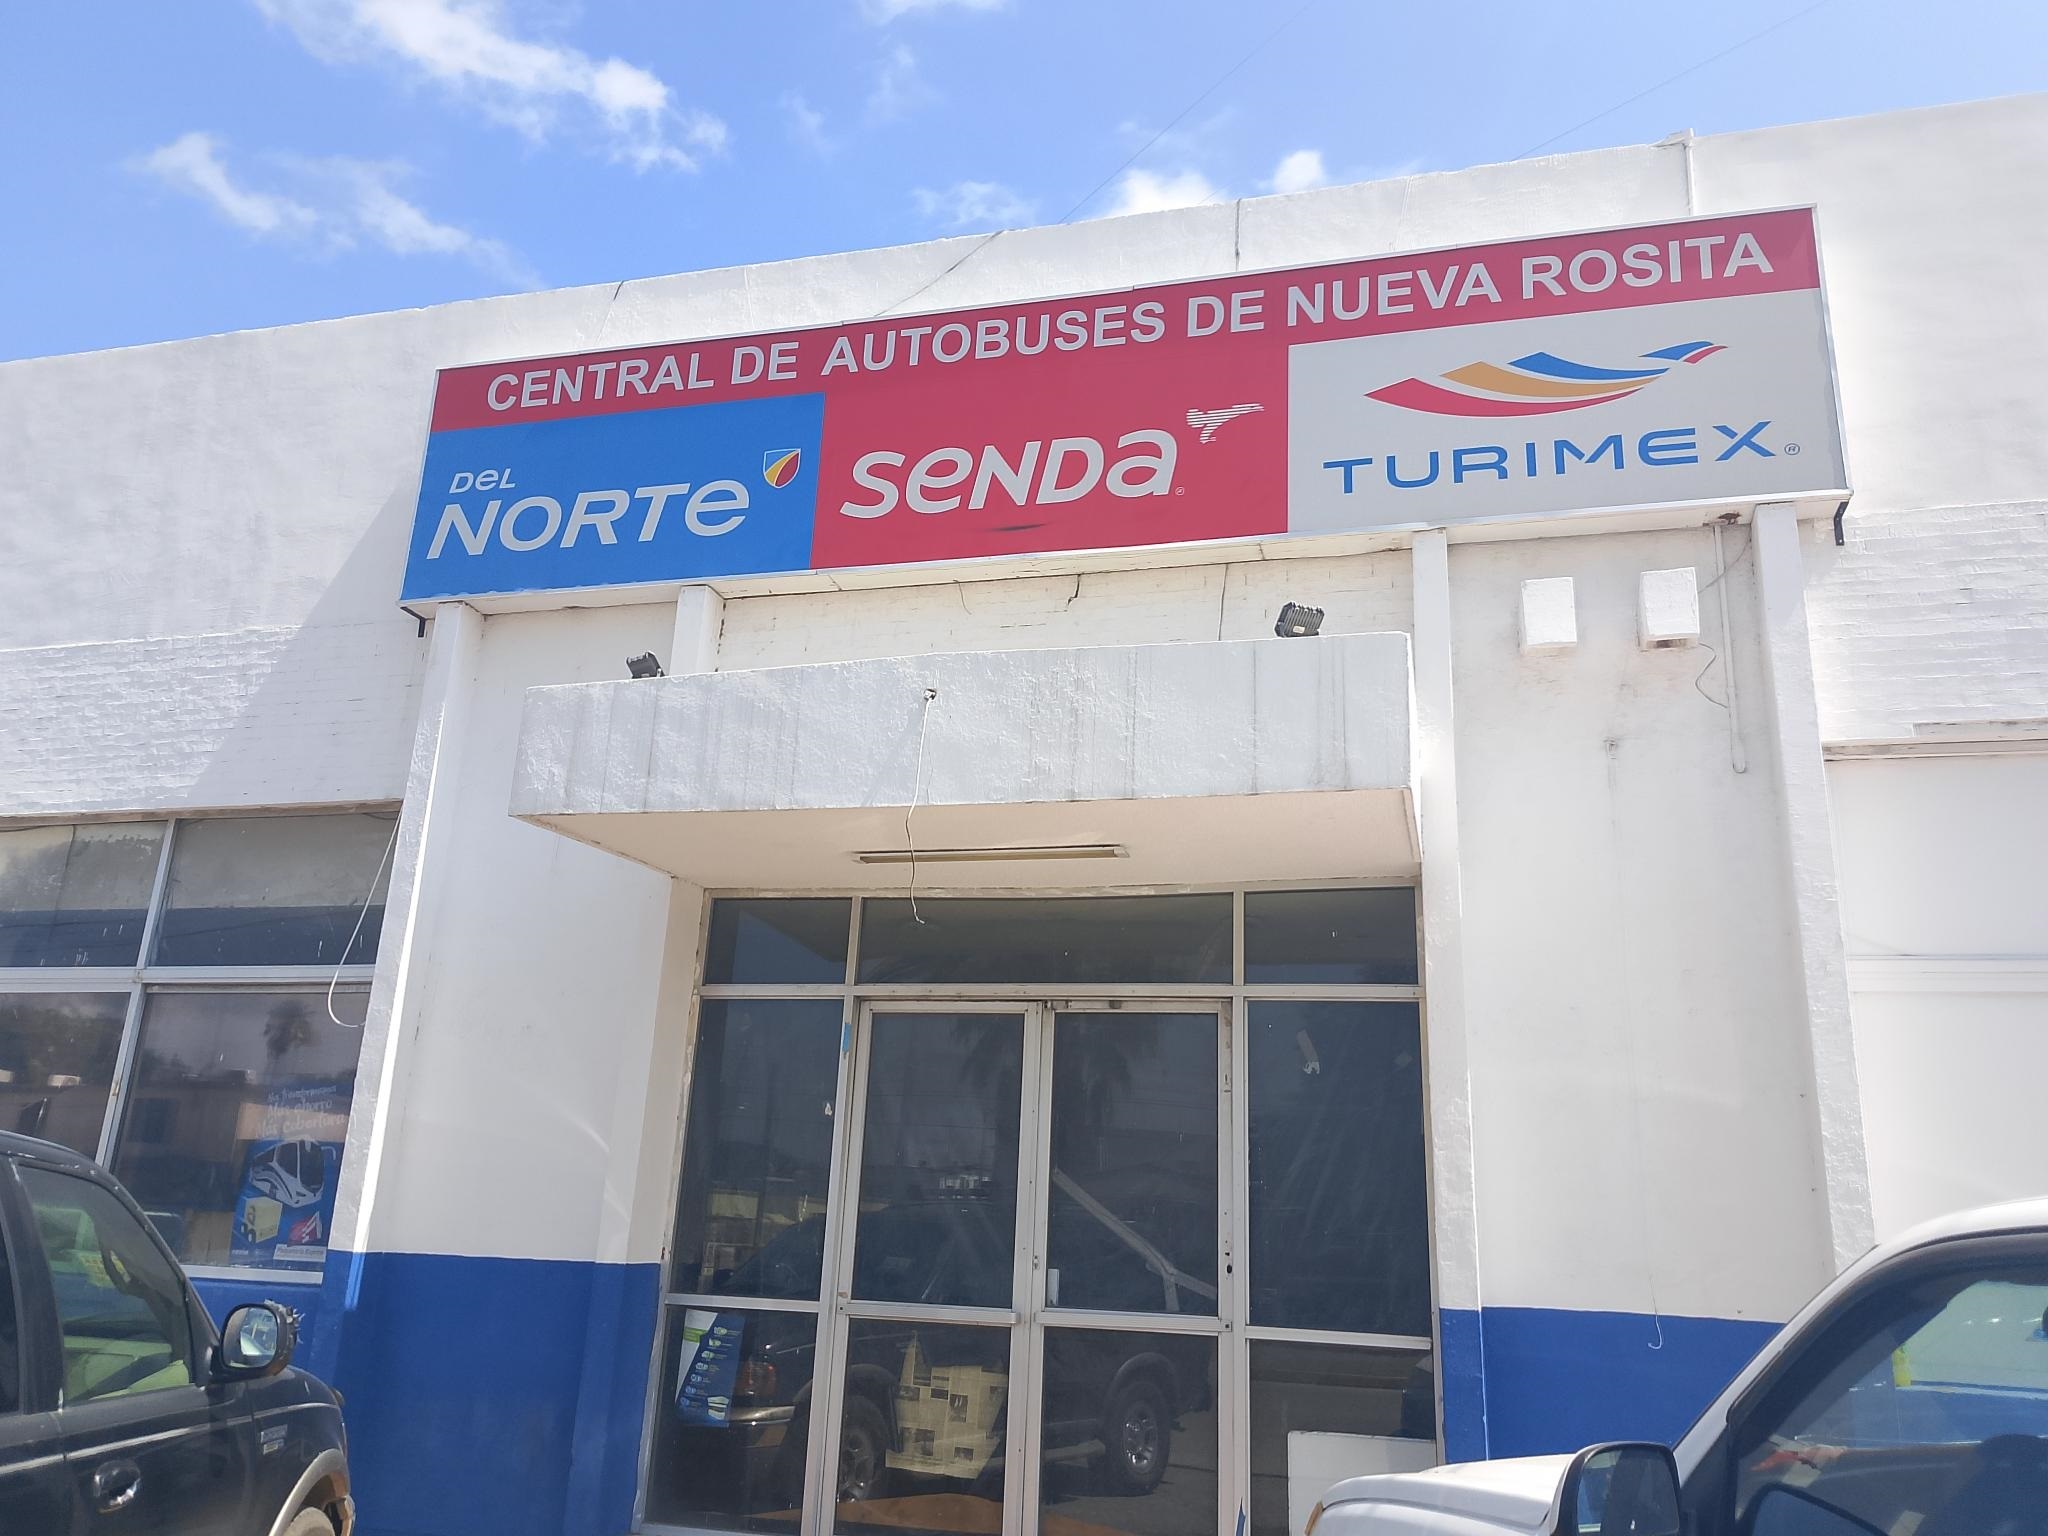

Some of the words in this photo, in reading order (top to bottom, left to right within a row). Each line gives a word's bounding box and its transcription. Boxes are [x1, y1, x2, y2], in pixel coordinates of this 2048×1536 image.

[487, 352, 715, 411] CENTRAL
[730, 341, 800, 385] DE
[820, 301, 1166, 376] AUTOBUSES
[1186, 289, 1266, 338] DE
[1286, 263, 1503, 327] NUEVA
[1520, 232, 1775, 300] ROSITA
[1322, 420, 1775, 495] TURIMEX
[282, 1111, 346, 1134] cobertura
[293, 1097, 334, 1113] ahorro
